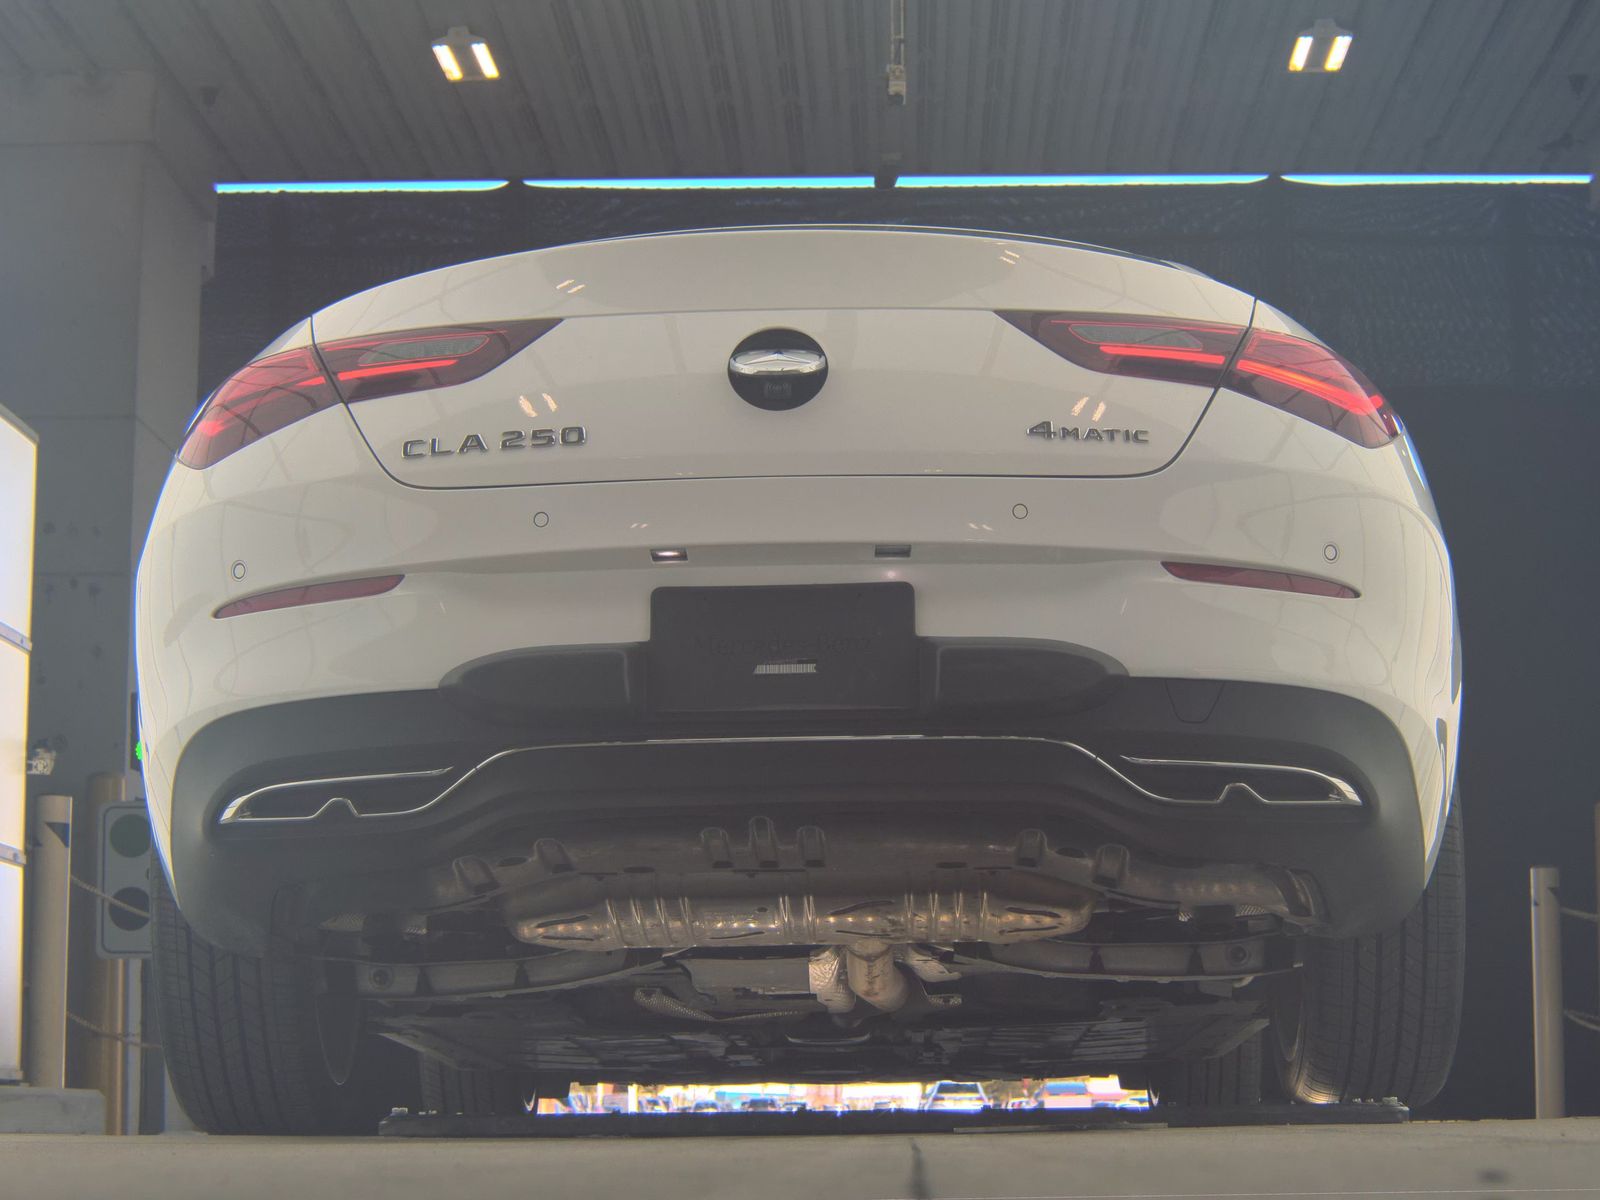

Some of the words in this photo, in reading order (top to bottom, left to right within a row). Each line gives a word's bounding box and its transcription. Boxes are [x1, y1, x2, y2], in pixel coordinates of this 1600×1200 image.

[402, 433, 489, 459] CLA
[500, 426, 587, 450] 250
[1026, 421, 1149, 443] 4MATIC
